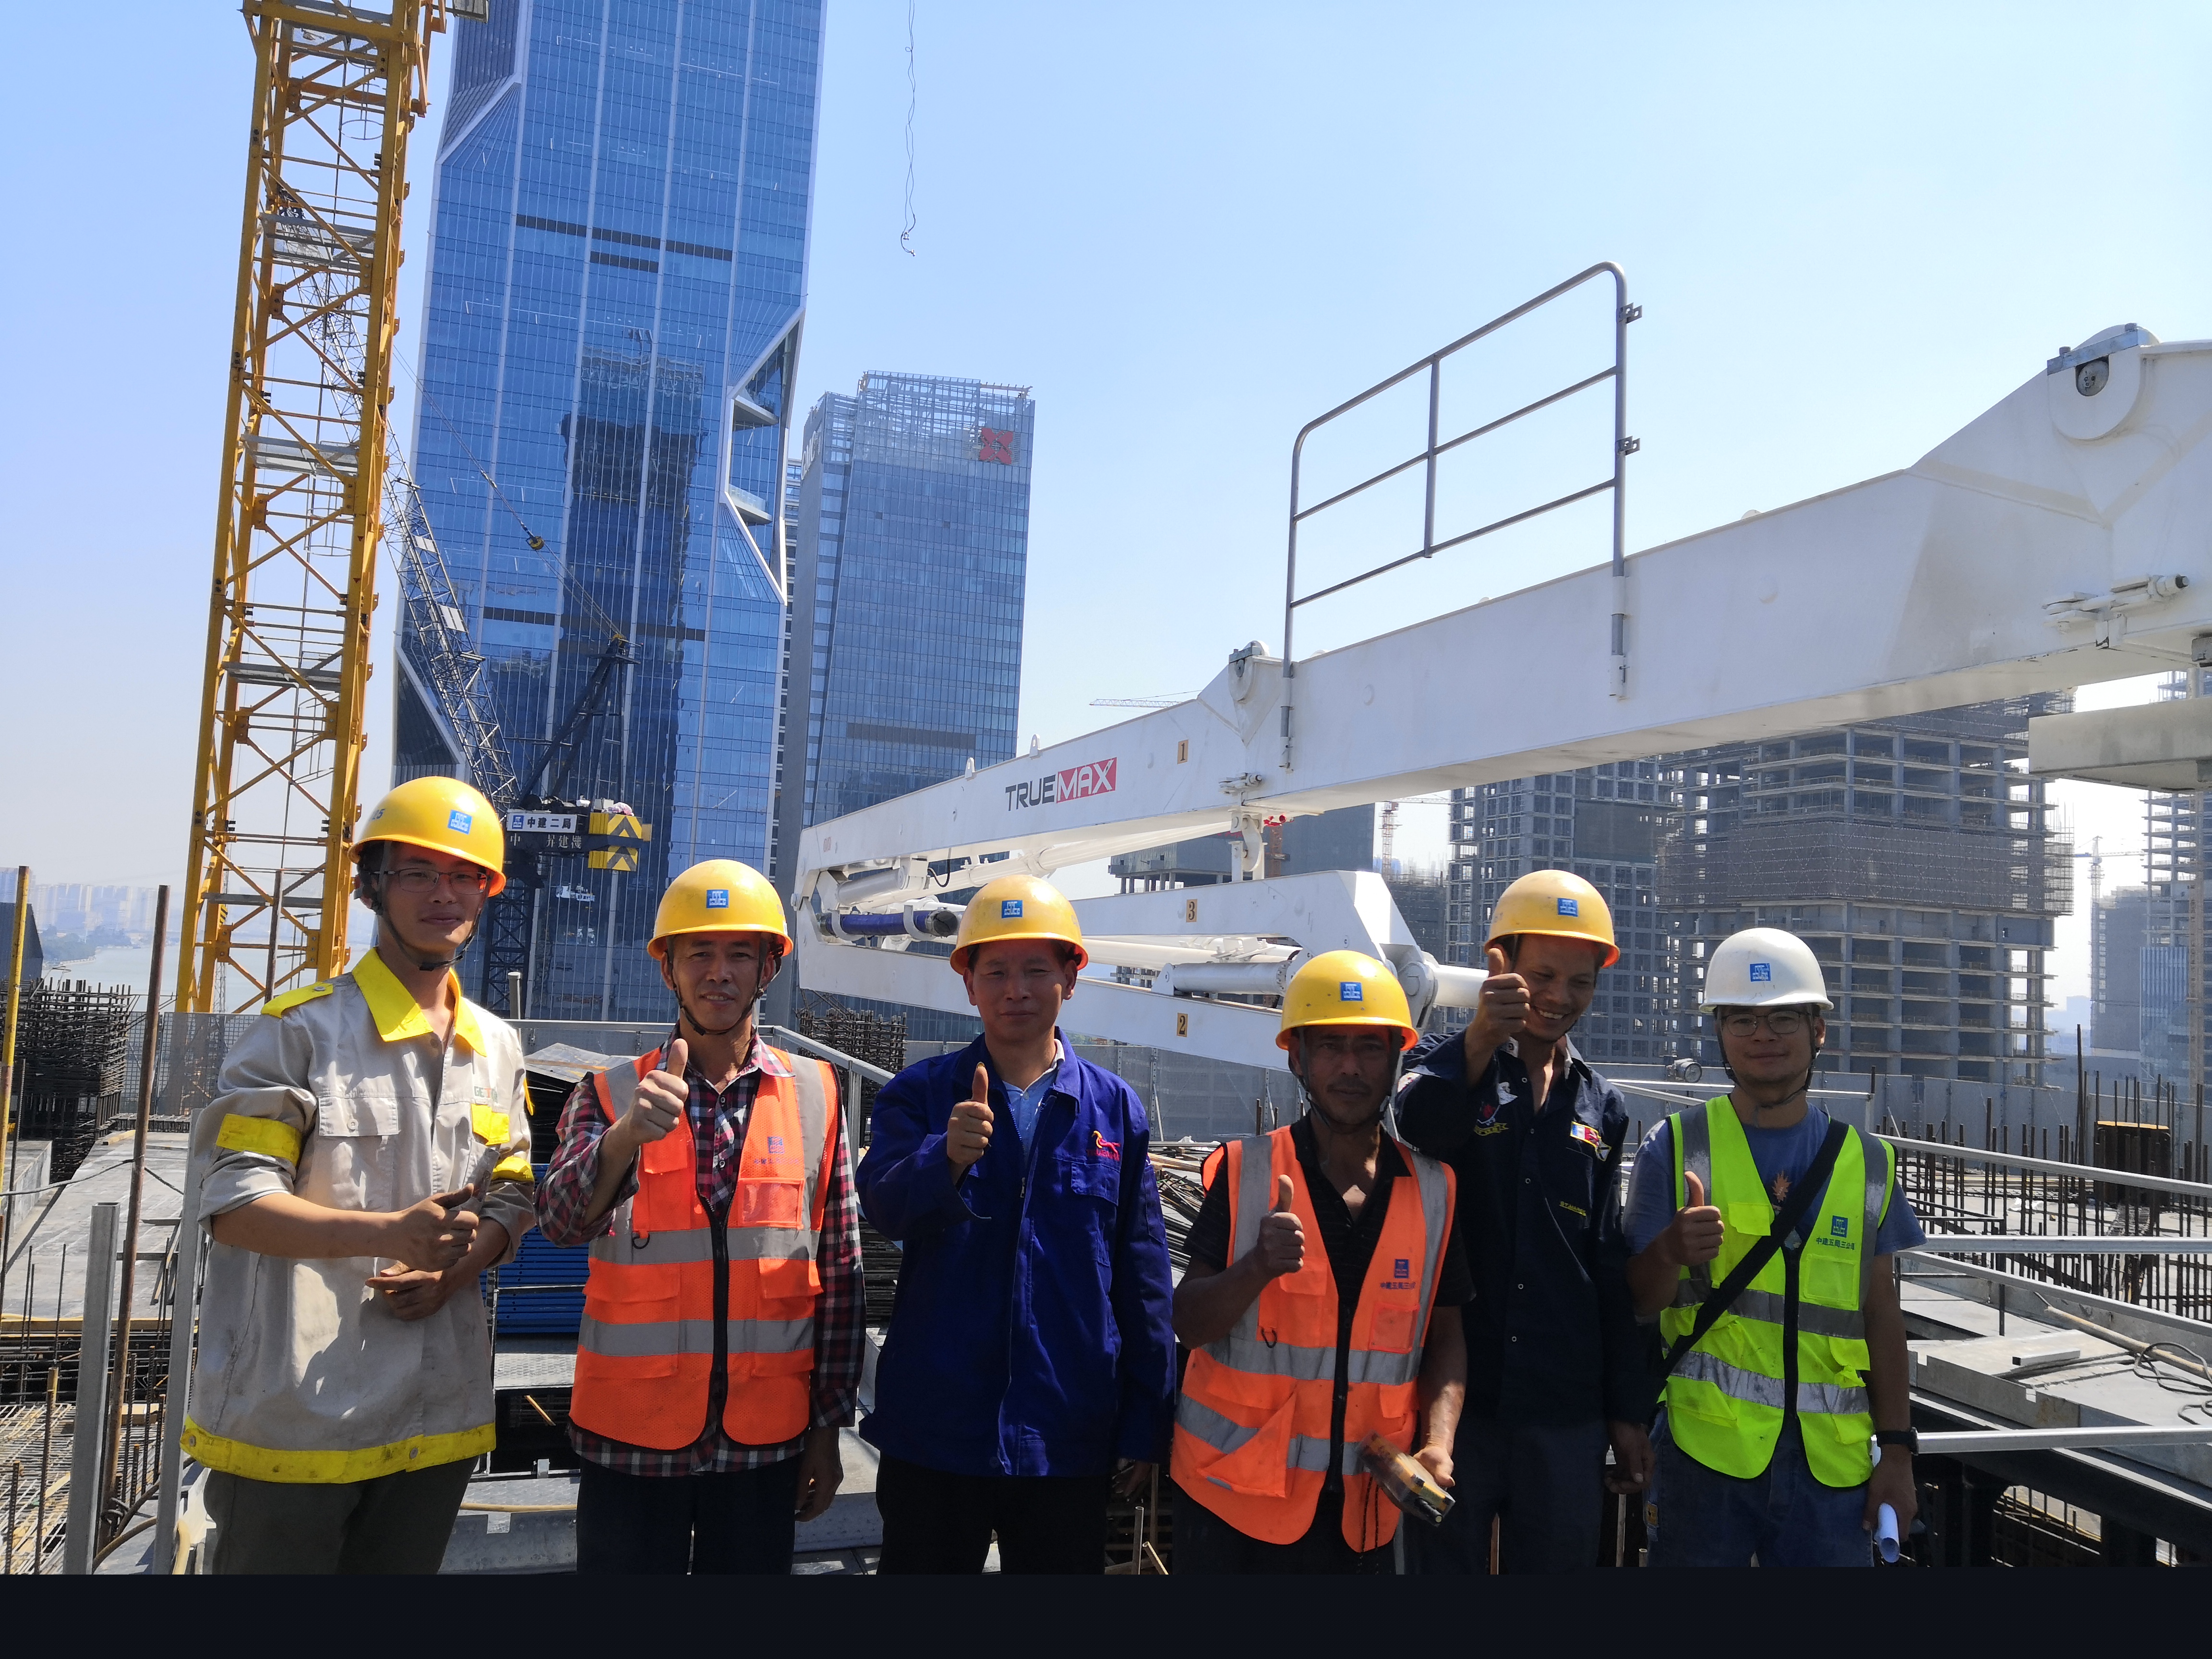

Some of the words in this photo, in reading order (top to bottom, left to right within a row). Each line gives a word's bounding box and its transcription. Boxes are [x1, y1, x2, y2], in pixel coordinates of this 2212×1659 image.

[1180, 743, 1186, 761] 1
[527, 817, 571, 829] 中建二局
[1188, 901, 1195, 920] 3
[1179, 1015, 1186, 1035] 2
